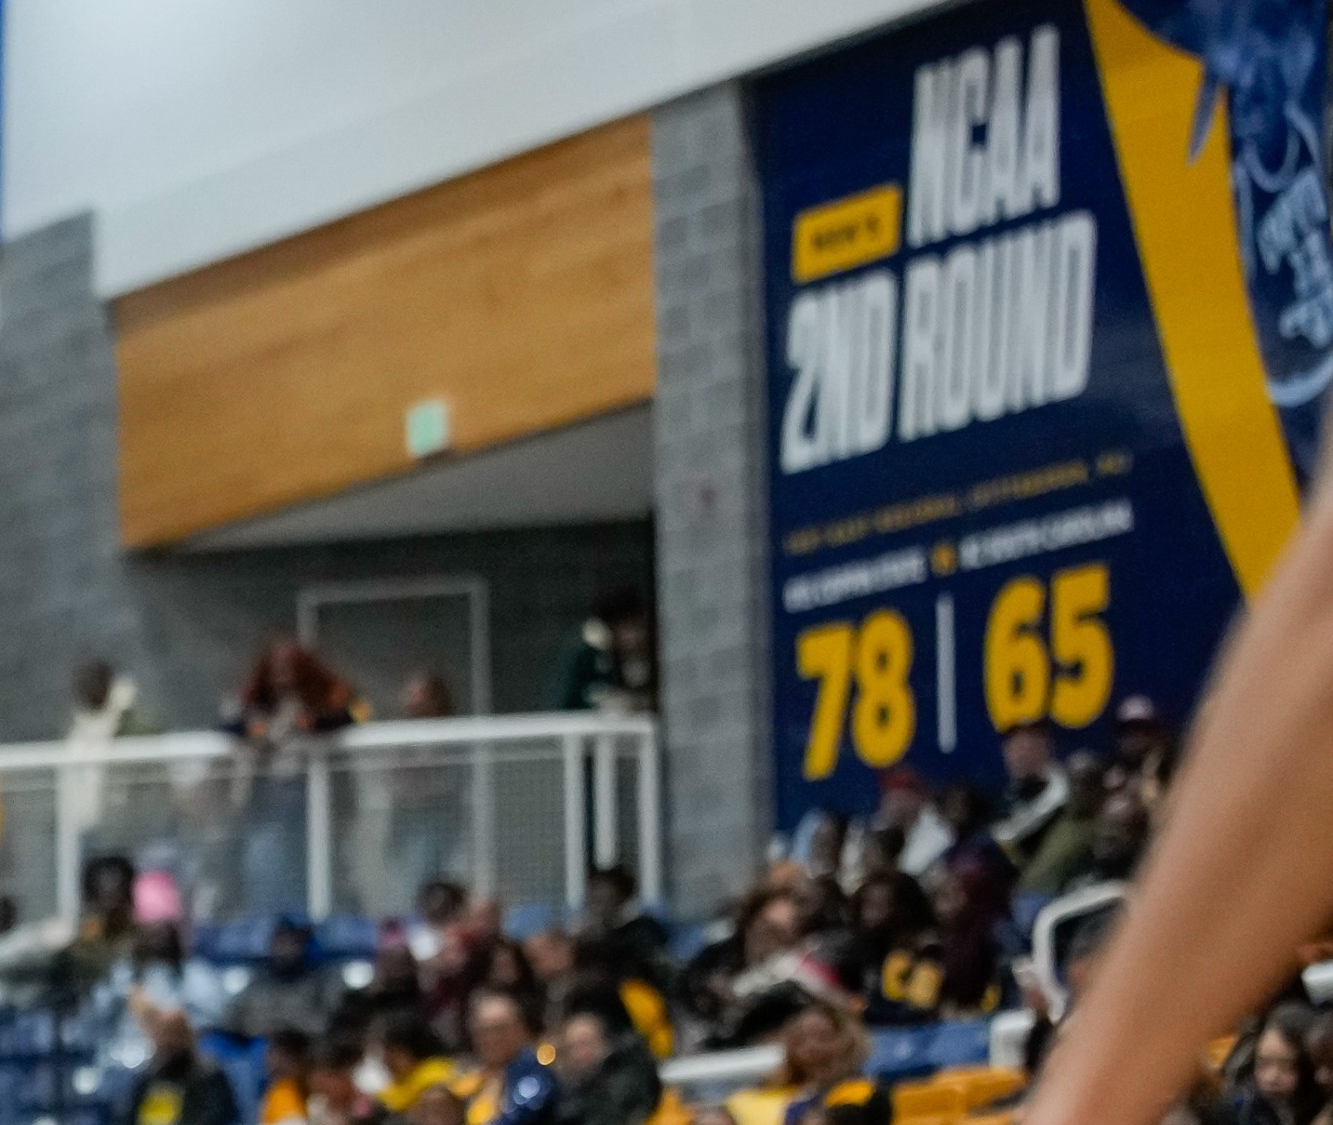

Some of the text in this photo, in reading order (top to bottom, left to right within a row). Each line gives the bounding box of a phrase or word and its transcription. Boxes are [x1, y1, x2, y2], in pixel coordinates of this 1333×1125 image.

[909, 24, 1061, 248] NCAA
[780, 271, 898, 474] 2ND
[898, 210, 1099, 442] ROUND
[794, 608, 917, 781] 78
[983, 563, 1115, 734] 65
